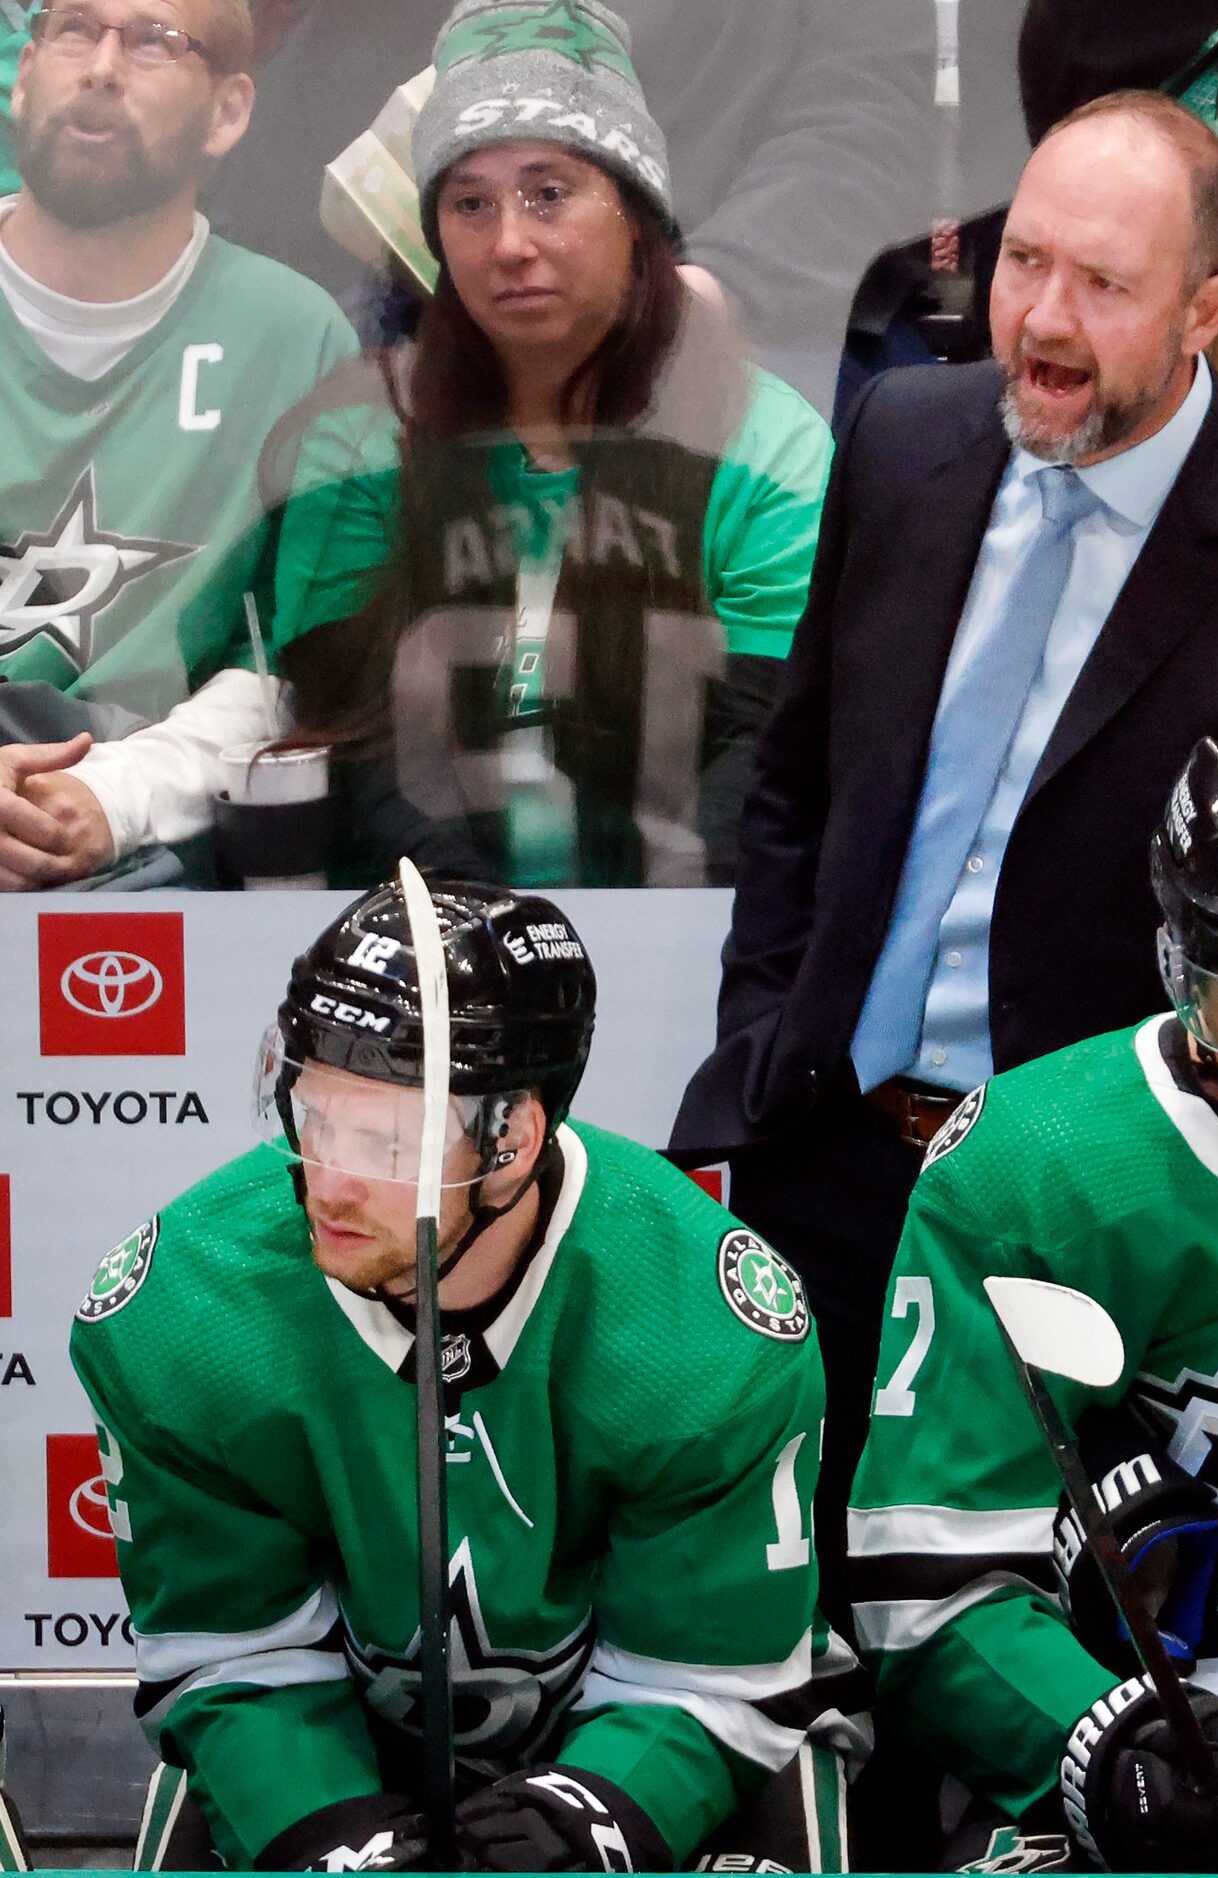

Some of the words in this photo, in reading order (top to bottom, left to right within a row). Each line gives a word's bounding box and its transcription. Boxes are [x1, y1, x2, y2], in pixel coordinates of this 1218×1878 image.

[455, 98, 666, 190] STARS
[178, 342, 224, 431] C
[526, 923, 570, 941] ENERGY
[347, 932, 402, 975] 12
[310, 993, 392, 1034] CCM
[16, 1091, 210, 1125] TOYOTA
